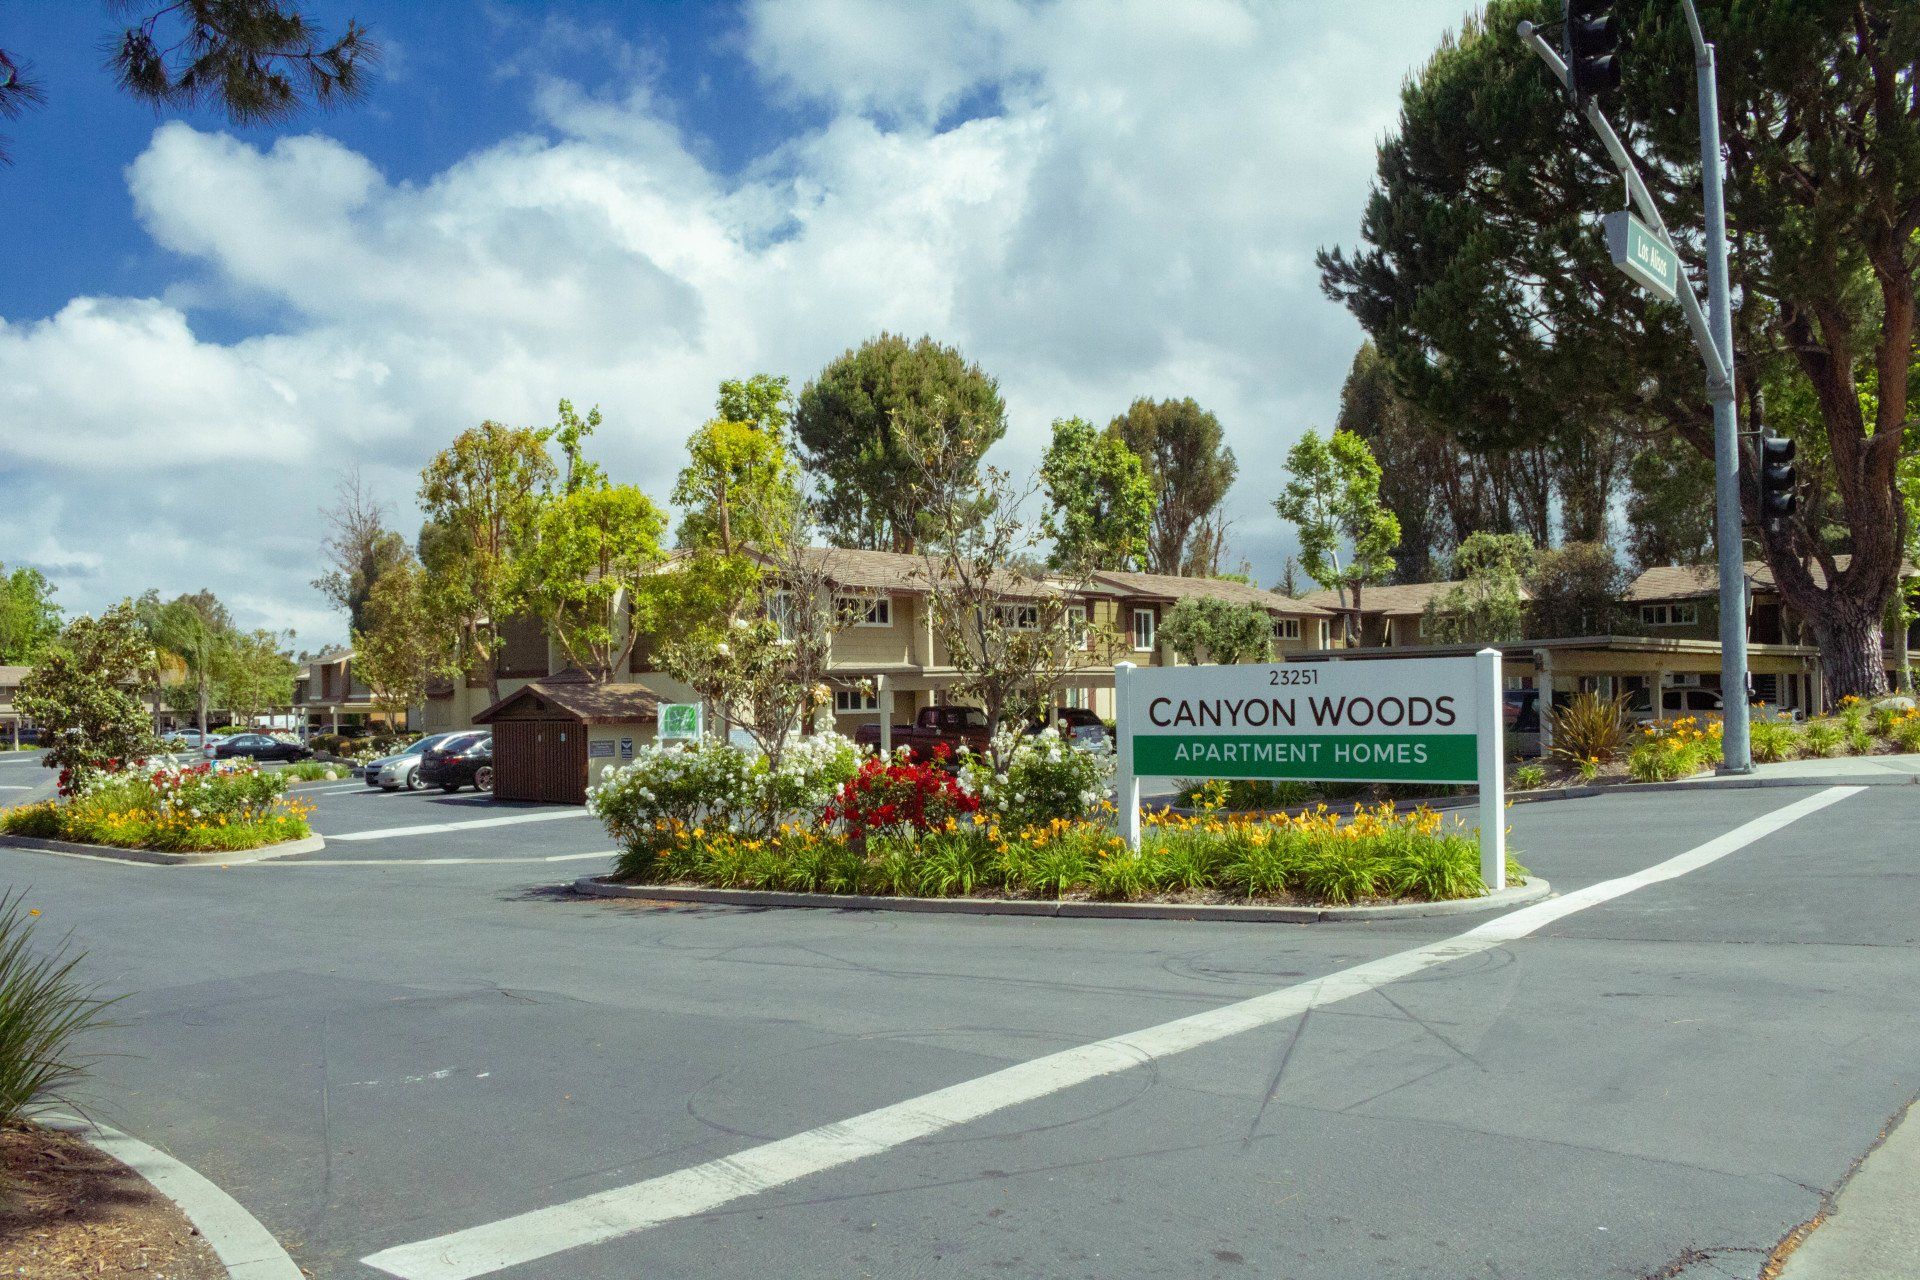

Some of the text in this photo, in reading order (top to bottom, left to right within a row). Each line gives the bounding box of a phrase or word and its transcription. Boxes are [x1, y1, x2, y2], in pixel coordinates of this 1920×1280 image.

[1637, 235, 1649, 263] Los
[1269, 669, 1319, 686] 23251
[1148, 695, 1457, 728] CANYON WOODS
[1174, 743, 1429, 764] APARTMENT HOMES
